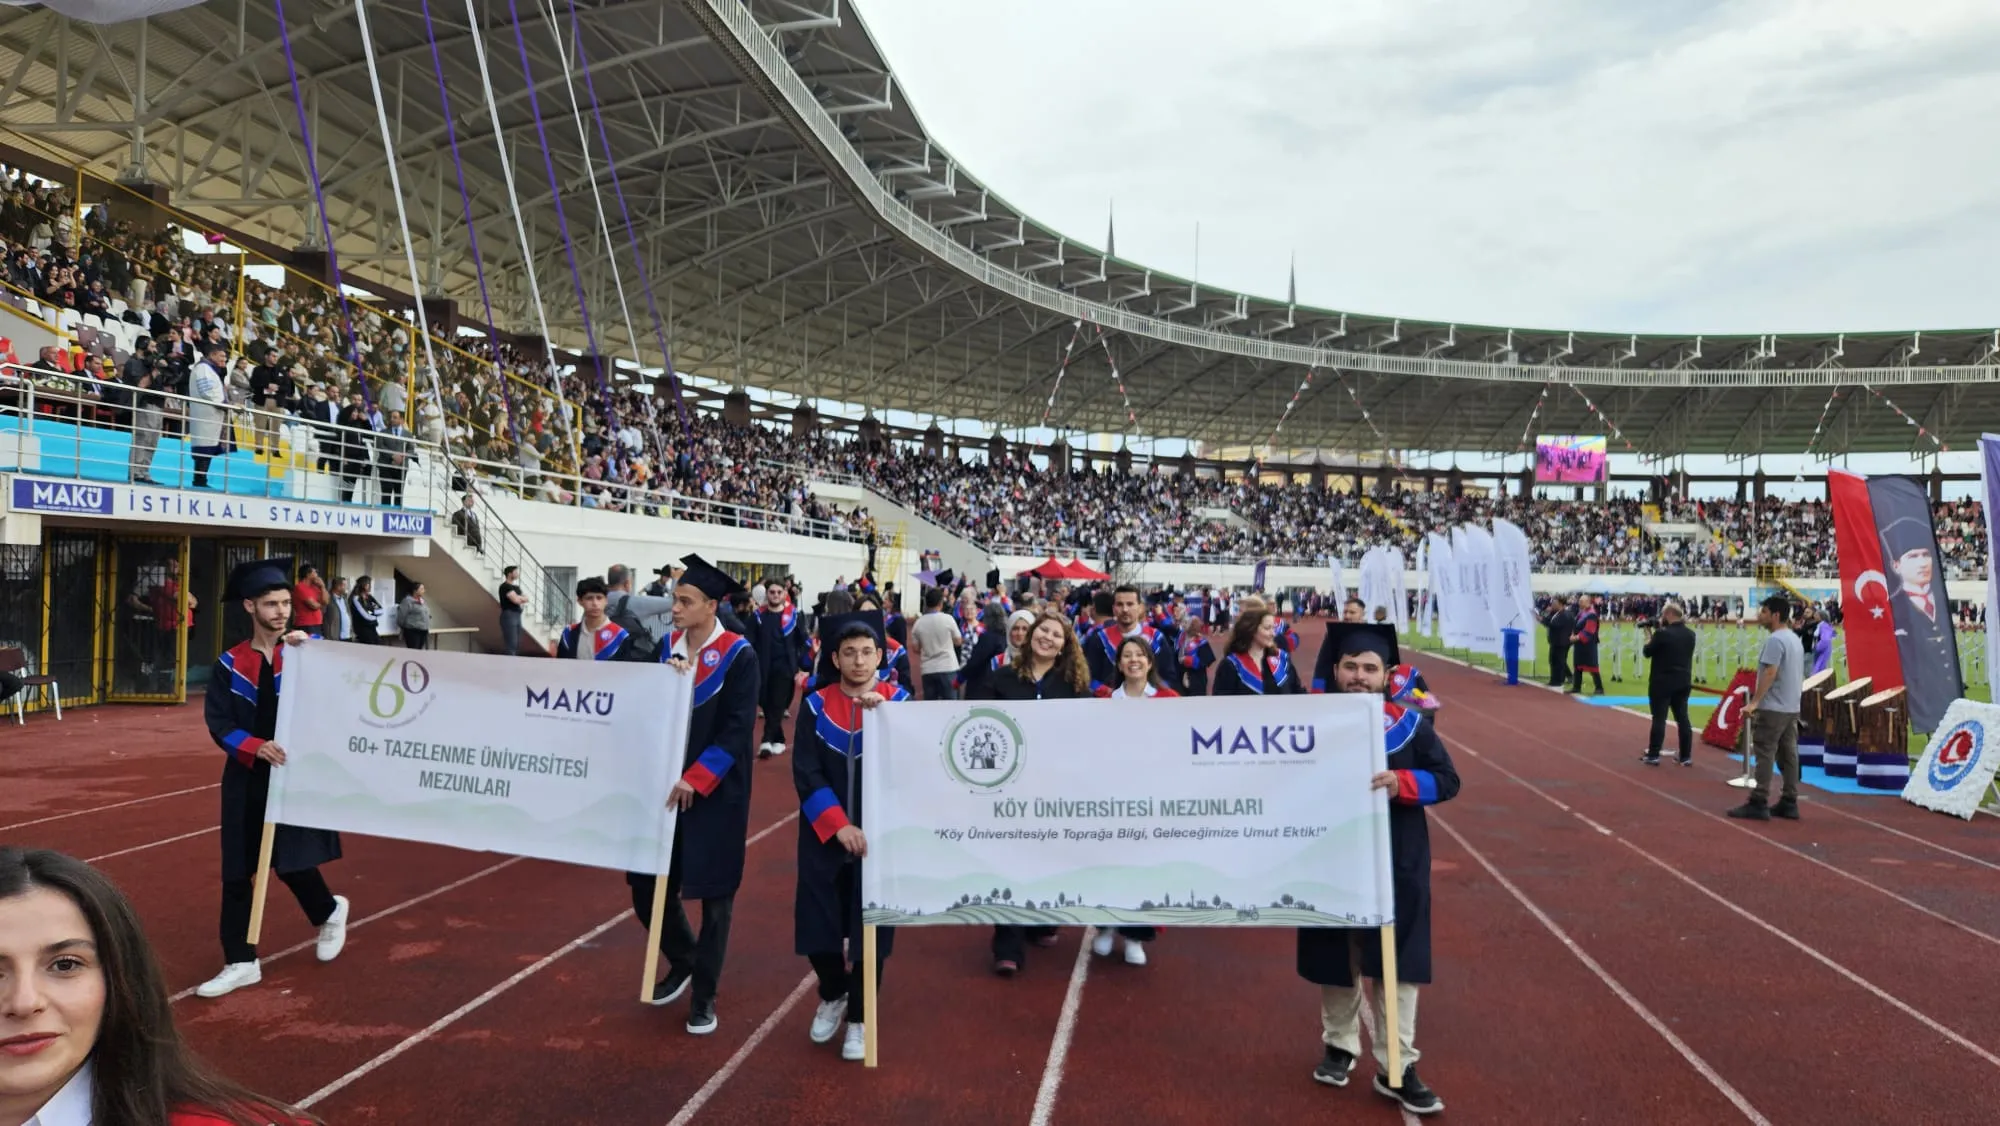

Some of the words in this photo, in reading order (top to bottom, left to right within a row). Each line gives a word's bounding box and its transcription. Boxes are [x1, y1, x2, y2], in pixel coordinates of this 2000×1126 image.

[33, 481, 103, 509] MAKÜ
[129, 489, 248, 519] İSTİKLAL
[269, 506, 374, 529] STADYUMU
[389, 514, 425, 532] MAKÜ
[526, 684, 615, 716] MAKÜ
[1191, 725, 1316, 754] MAKÜ
[348, 735, 379, 755] 60+
[384, 739, 476, 765] TAZELENME
[480, 745, 589, 779] ÜNİVERSİTESİ
[418, 770, 511, 797] MEZUNLARI
[993, 797, 1028, 818] KÖY
[1034, 796, 1153, 818] ÜNİVERSİTESİ
[1160, 798, 1263, 817] MEZUNLARI
[934, 828, 964, 842] “Köy
[967, 826, 1058, 842] Üniversitesiyle
[1063, 828, 1113, 842] Toprağa
[1117, 827, 1148, 841] Bilgi,
[1153, 826, 1239, 841] Geleceğimize
[1243, 827, 1279, 838] Umut
[1283, 825, 1327, 838] Ektik!”
